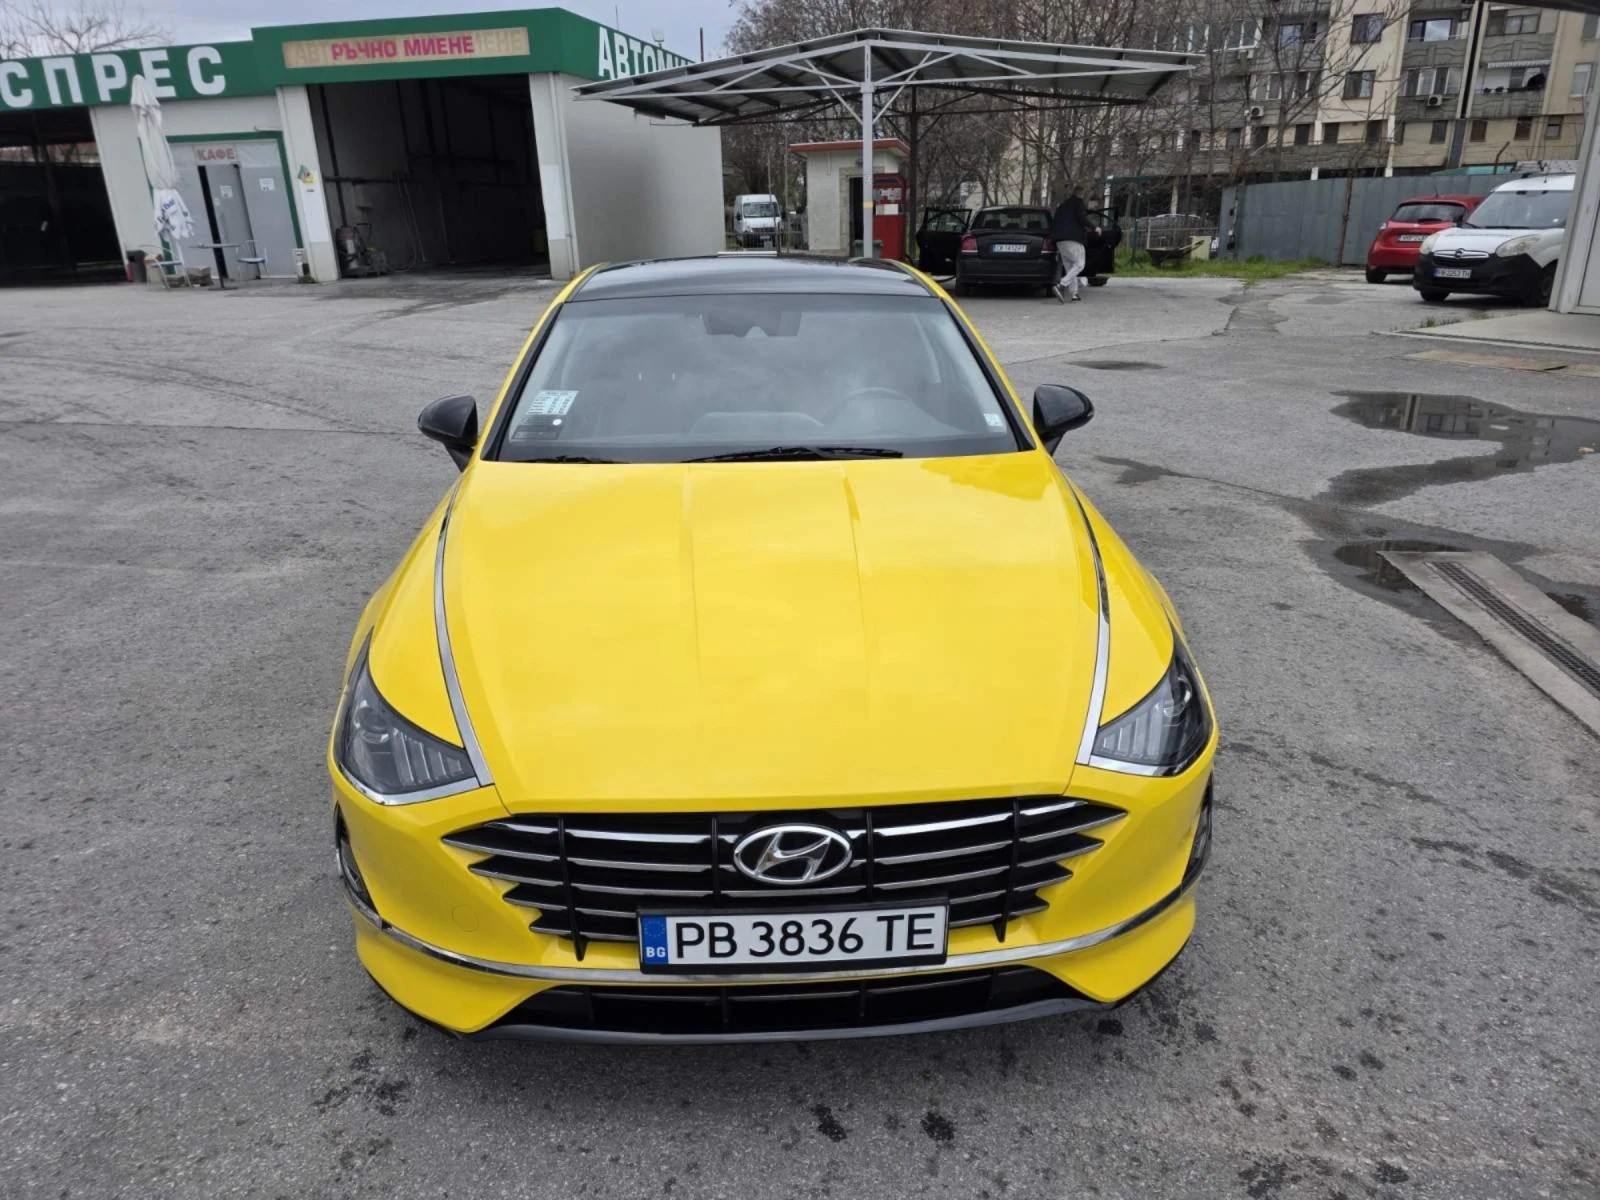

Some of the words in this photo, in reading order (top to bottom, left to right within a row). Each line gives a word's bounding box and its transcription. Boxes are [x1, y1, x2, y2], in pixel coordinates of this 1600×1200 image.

[331, 40, 398, 61] РЪЧНО
[403, 35, 475, 57] МИЕНЕ
[197, 148, 235, 161] КАФЕ
[676, 922, 737, 958] PB
[749, 917, 864, 957] 3836
[877, 913, 935, 951] TE
[646, 947, 666, 958] BG
